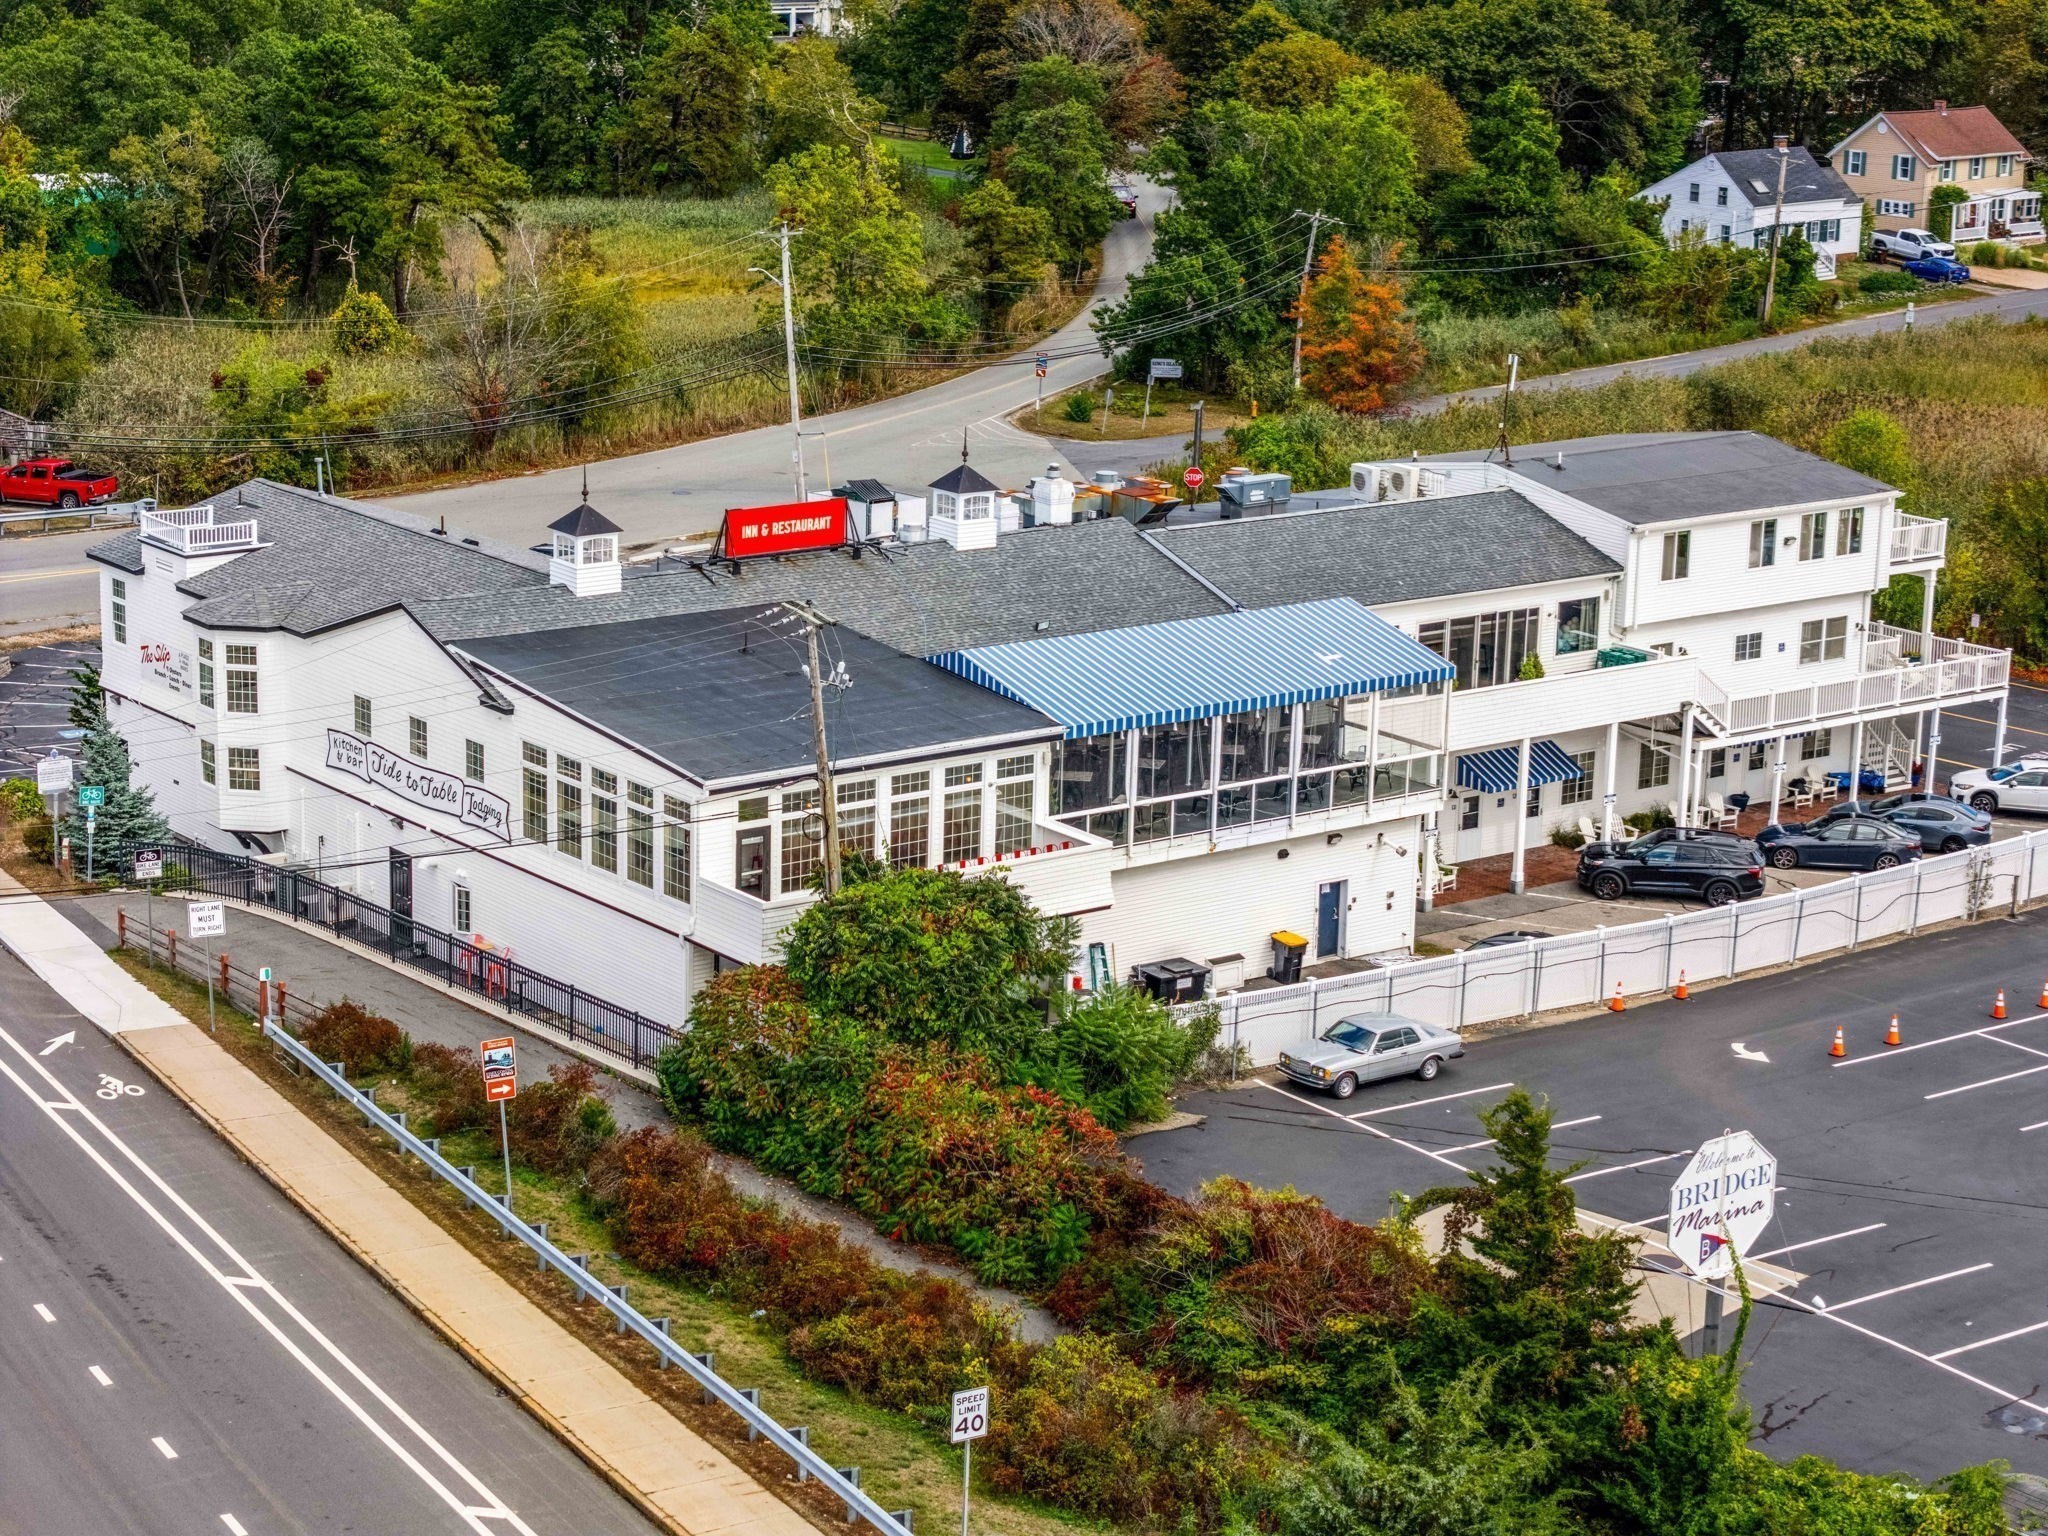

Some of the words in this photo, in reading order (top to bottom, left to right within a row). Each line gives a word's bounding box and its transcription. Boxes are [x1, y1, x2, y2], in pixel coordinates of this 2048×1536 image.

[742, 525, 758, 539] INN
[761, 523, 770, 537] &
[772, 516, 832, 536] RESTAURANT
[140, 645, 153, 664] The
[154, 644, 171, 669] Slip
[333, 737, 363, 757] Kitchen
[346, 753, 364, 769] bar
[372, 750, 402, 783] Tide
[406, 771, 419, 792] to
[420, 776, 458, 803] Table
[465, 791, 503, 828] Lodging
[207, 904, 221, 912] LANE
[197, 914, 215, 923] MUST
[1677, 1163, 1772, 1211] BRIDGE
[1673, 1200, 1765, 1238] Marina
[1701, 1240, 1711, 1259] B
[956, 1393, 985, 1405] SPEED
[958, 1404, 981, 1415] LIMIT
[955, 1414, 984, 1434] 40
